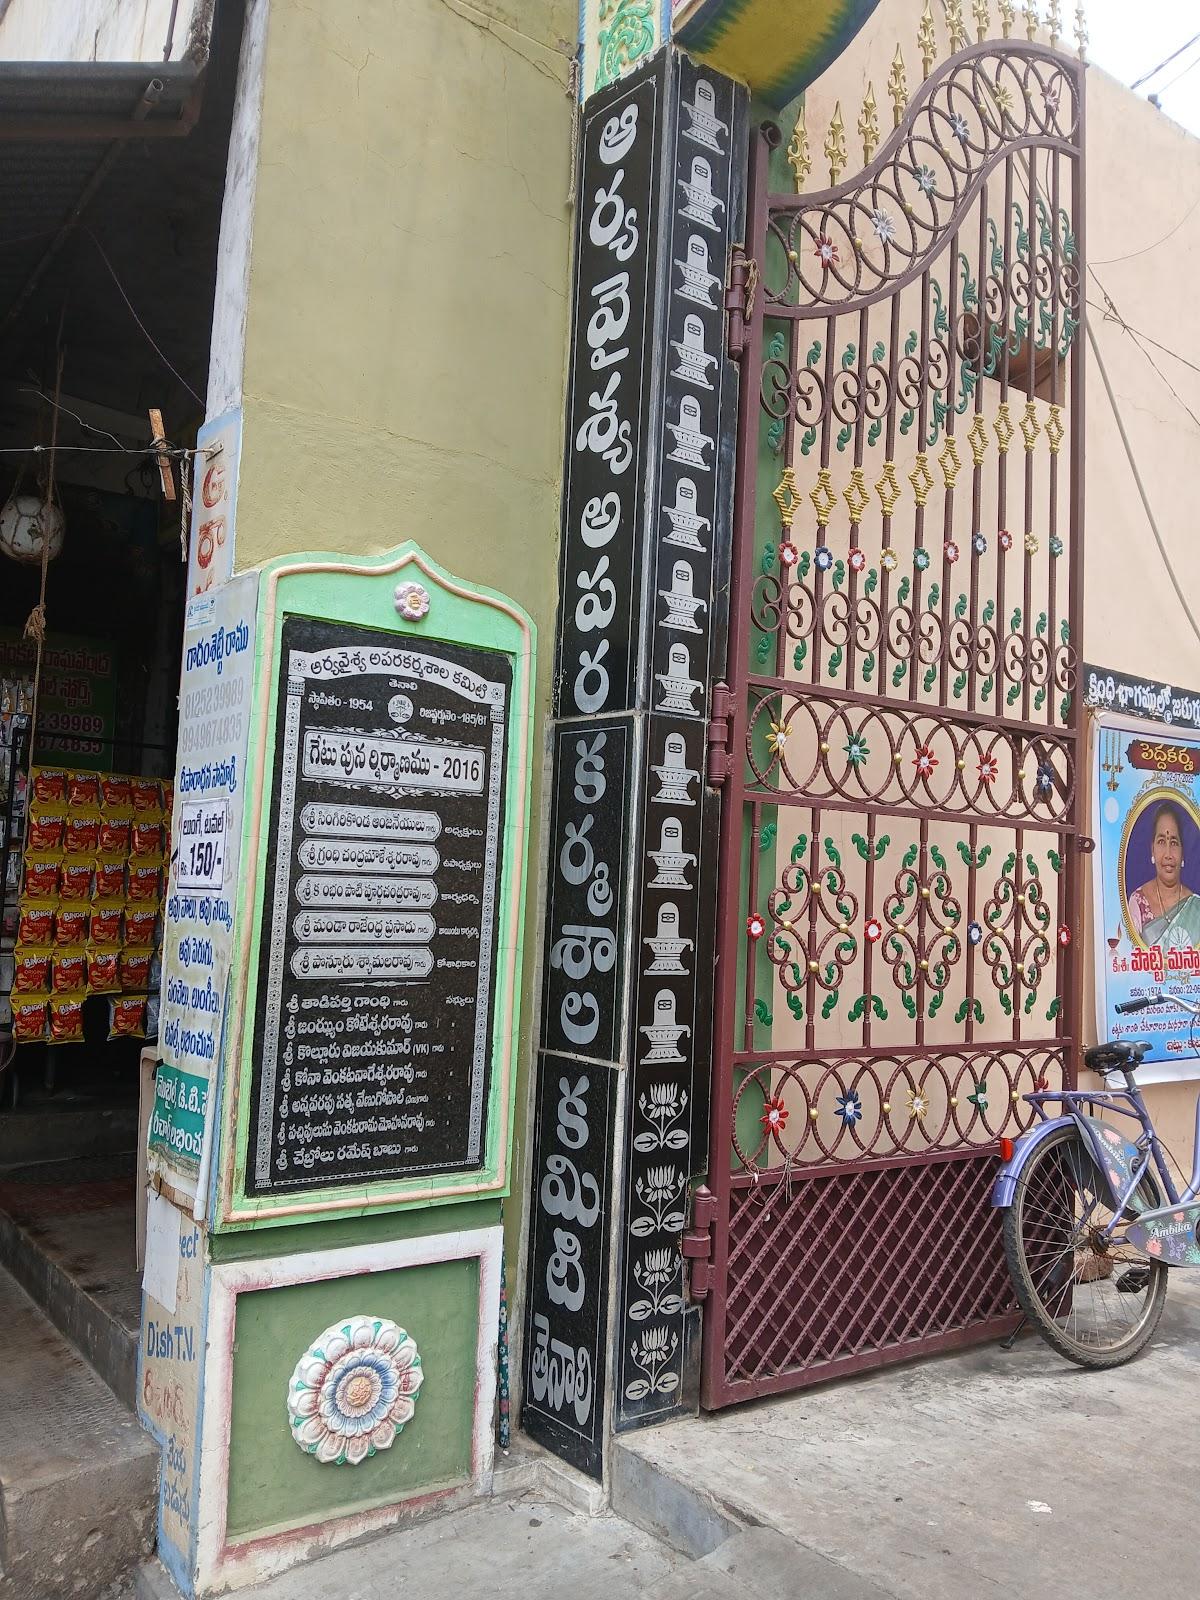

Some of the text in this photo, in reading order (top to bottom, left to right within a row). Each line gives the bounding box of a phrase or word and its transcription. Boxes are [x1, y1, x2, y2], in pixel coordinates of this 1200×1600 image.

[225, 619, 249, 657] రాము
[311, 651, 367, 676] ఆర్యవైశ్య
[389, 678, 418, 692] తెనాలి
[349, 698, 373, 712] 1954
[309, 734, 337, 767] గేటు
[443, 757, 480, 782] 2016
[1140, 742, 1194, 771] పెద్దకర్మ
[306, 808, 316, 826] శ్రీ
[372, 814, 425, 832] ఆంజనేయులు
[190, 841, 222, 880] 150/-
[306, 844, 316, 864] శ్రీ
[303, 880, 312, 900] శ్రీ
[29, 911, 52, 920] BINGO!
[63, 912, 86, 922] BINGO!
[101, 909, 121, 920] BINGO!
[133, 912, 157, 923] BINGO!
[301, 916, 311, 936] శ్రీ
[24, 957, 47, 968] BINGO!
[61, 957, 83, 968] BINGO!
[97, 953, 118, 965] BINGO!
[128, 956, 149, 967] BINGO!
[299, 952, 310, 973] శ్రీ
[21, 1004, 44, 1015] BINGO!
[60, 1002, 82, 1015] BINGO!
[123, 999, 143, 1009] BINGO!
[286, 994, 300, 1013] శ్రీ
[284, 1015, 296, 1039] శ్రీ
[282, 1041, 294, 1065] శ్రీ
[412, 1043, 430, 1056] (VK)
[280, 1068, 292, 1092] శ్రీ
[279, 1094, 289, 1118] శ్రీ
[277, 1122, 286, 1145] శ్రీ
[276, 1148, 288, 1170] శ్రీ
[1149, 1222, 1192, 1240] Ambika
